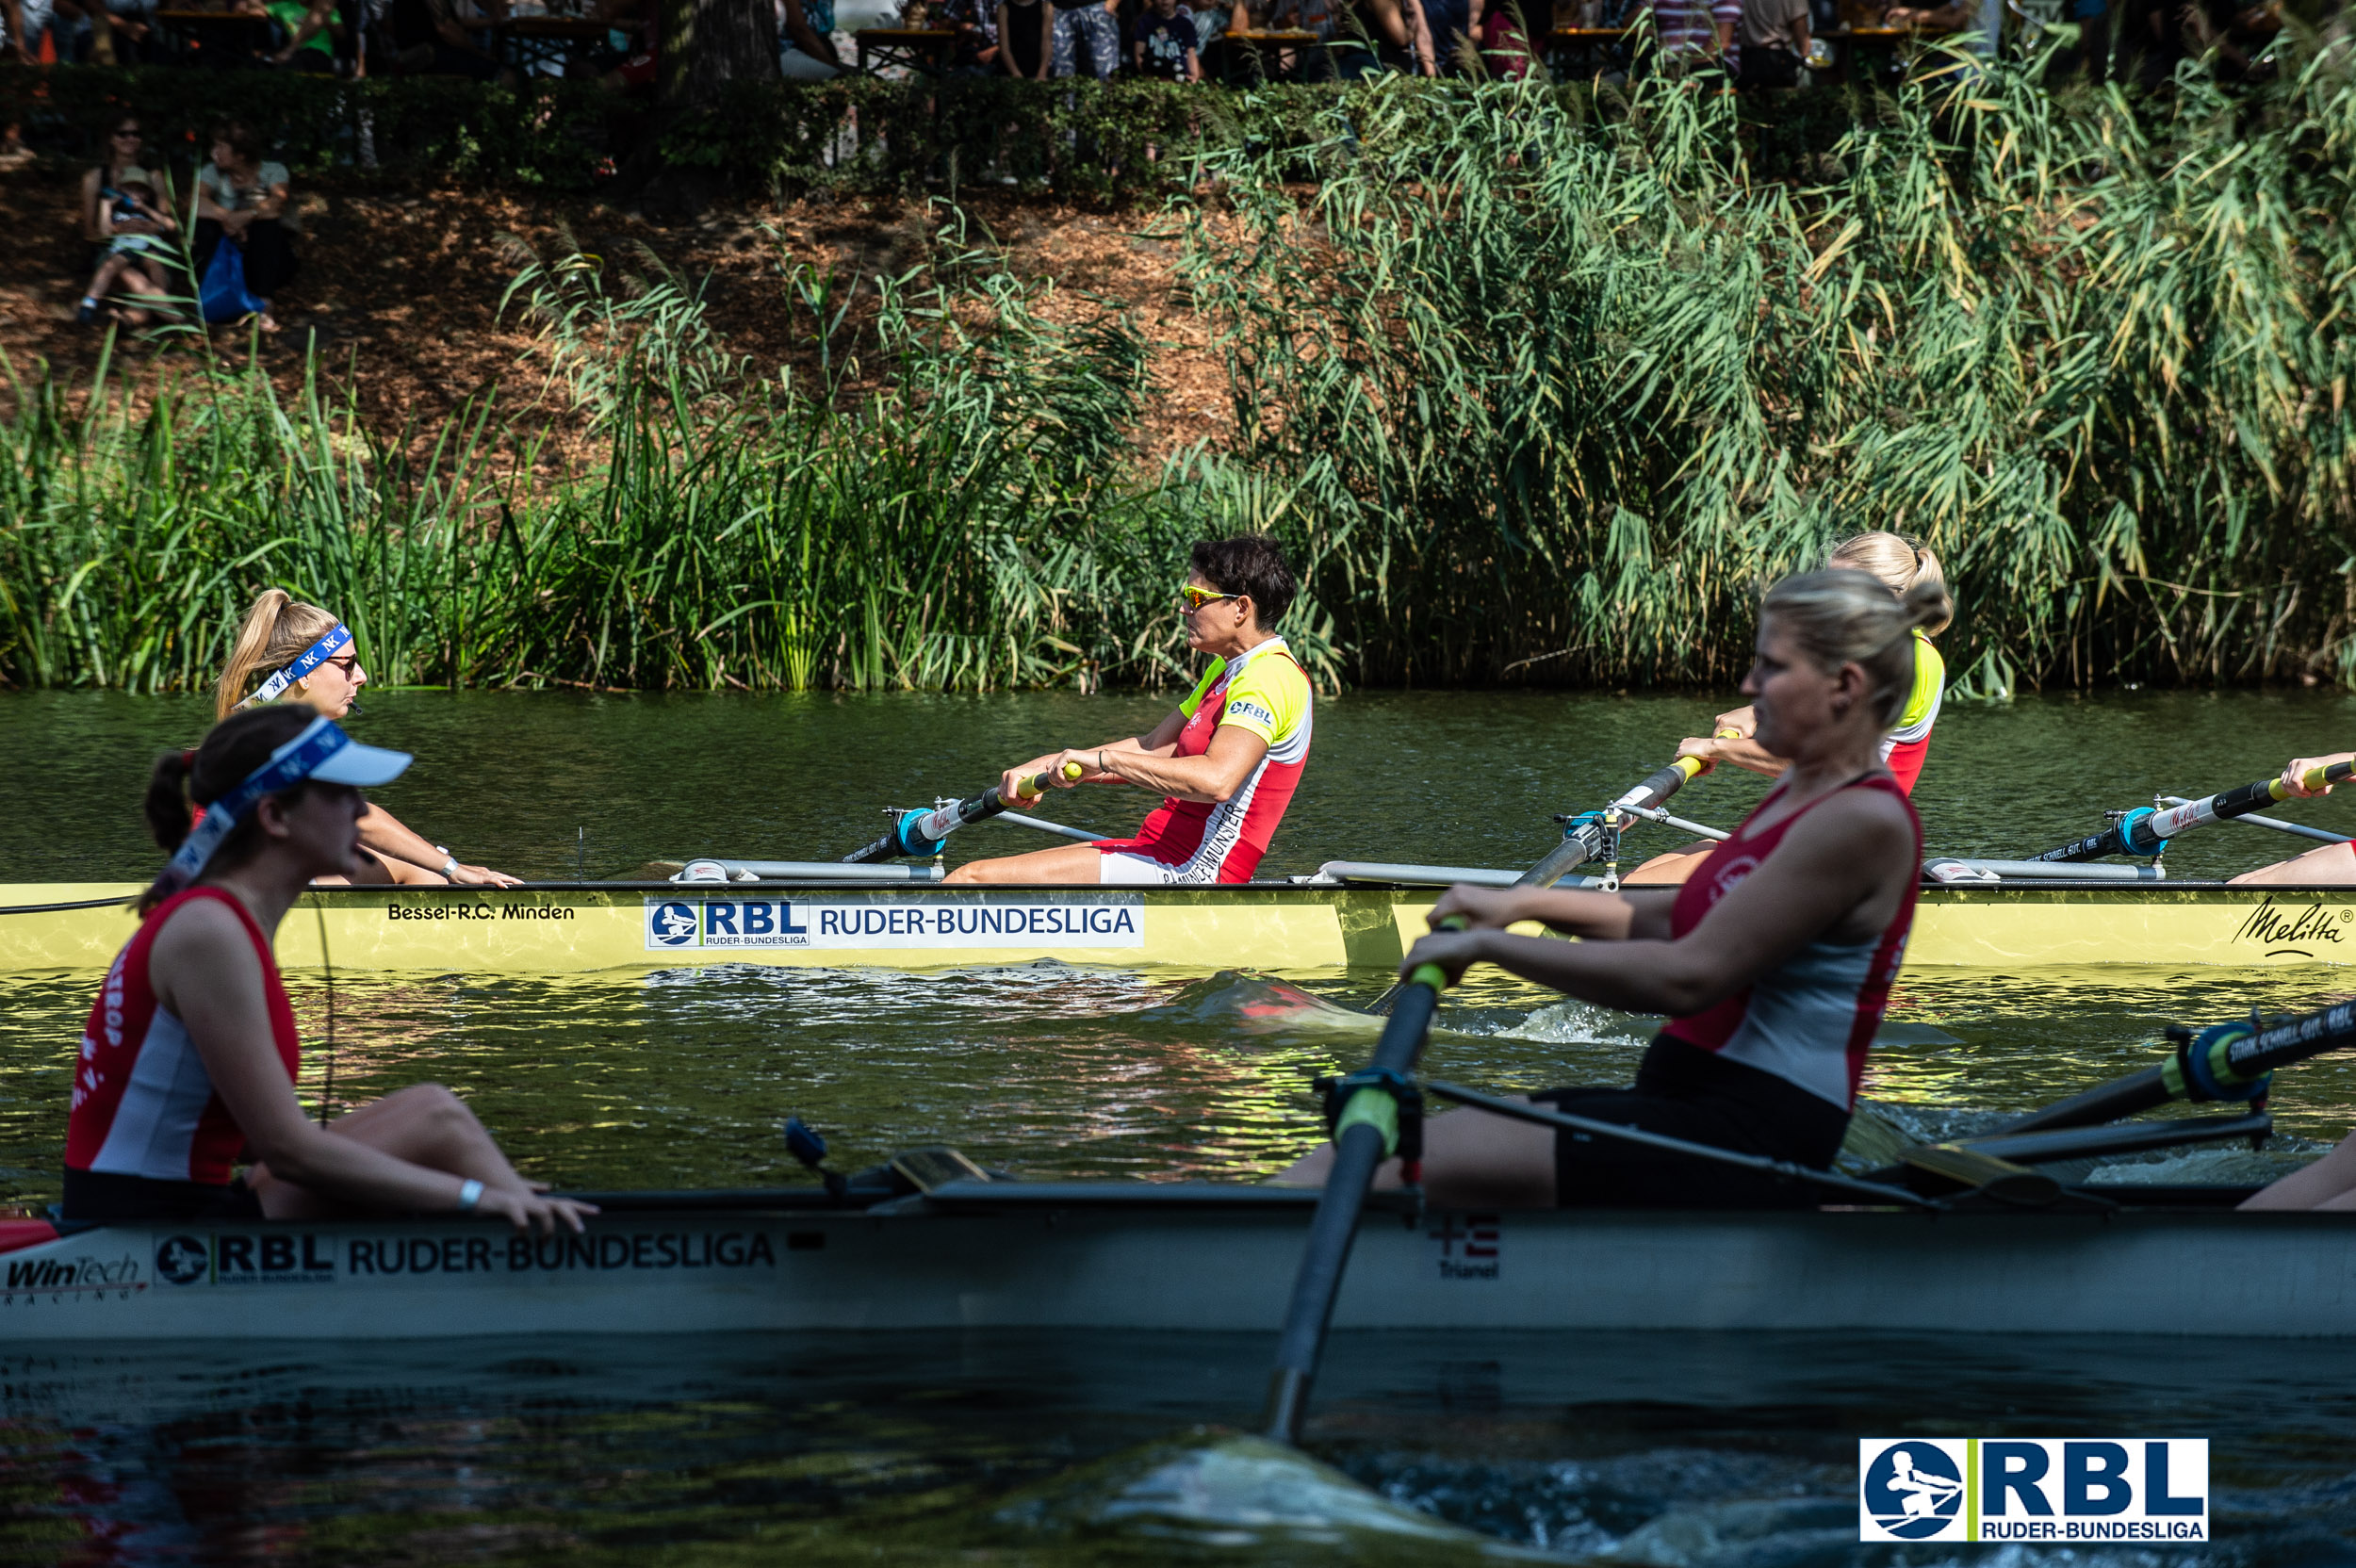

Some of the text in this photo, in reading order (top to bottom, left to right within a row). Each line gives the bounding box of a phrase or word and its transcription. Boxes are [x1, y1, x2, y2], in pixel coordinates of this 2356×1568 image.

[300, 650, 319, 670] NK
[321, 635, 340, 652] NK
[1243, 703, 1271, 725] RBL
[388, 903, 575, 920] Bessel-R.C. Minden
[706, 901, 807, 935] RBL
[821, 907, 1135, 936] RUDER-BUNDESLIGA
[706, 937, 808, 945] RUDER-BUNDESLIGA
[219, 1234, 334, 1272] RBL
[351, 1232, 776, 1274] RUDER-BUNDESLIGA
[8, 1254, 139, 1287] WinTech
[1439, 1260, 1499, 1280] Trianel
